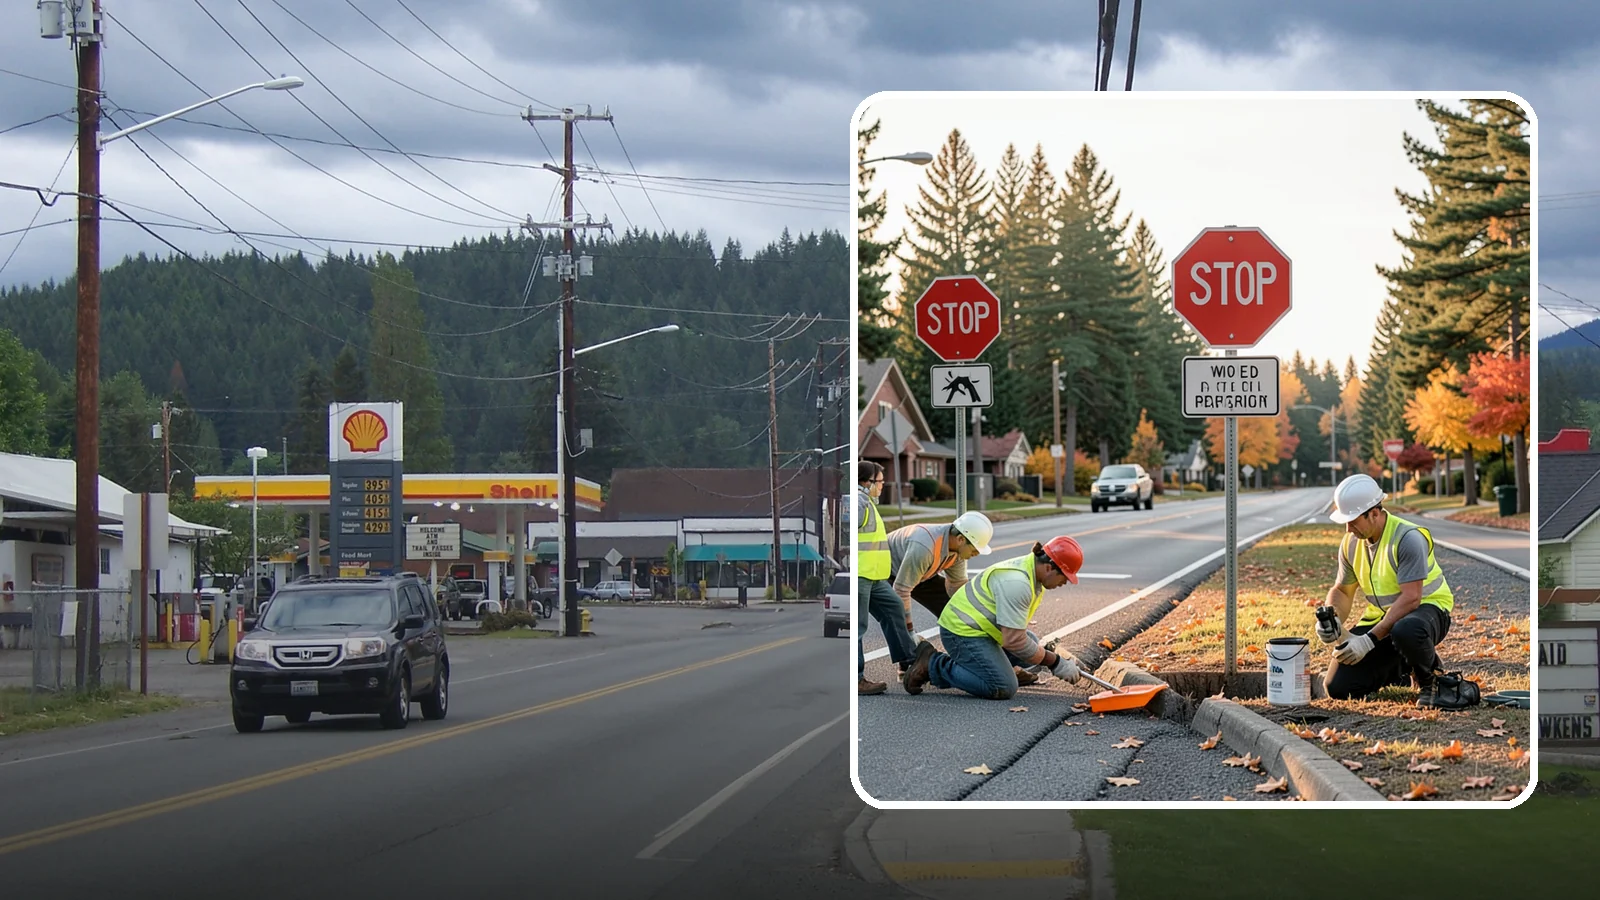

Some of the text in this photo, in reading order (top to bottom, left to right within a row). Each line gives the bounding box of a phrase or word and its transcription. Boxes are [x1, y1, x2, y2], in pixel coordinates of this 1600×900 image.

[1190, 261, 1277, 306] STOP
[927, 301, 990, 335] STOP
[366, 480, 383, 490] 395
[490, 485, 547, 499] Shell
[366, 494, 383, 504] 405
[366, 508, 383, 518] 415
[365, 522, 383, 532] 429
